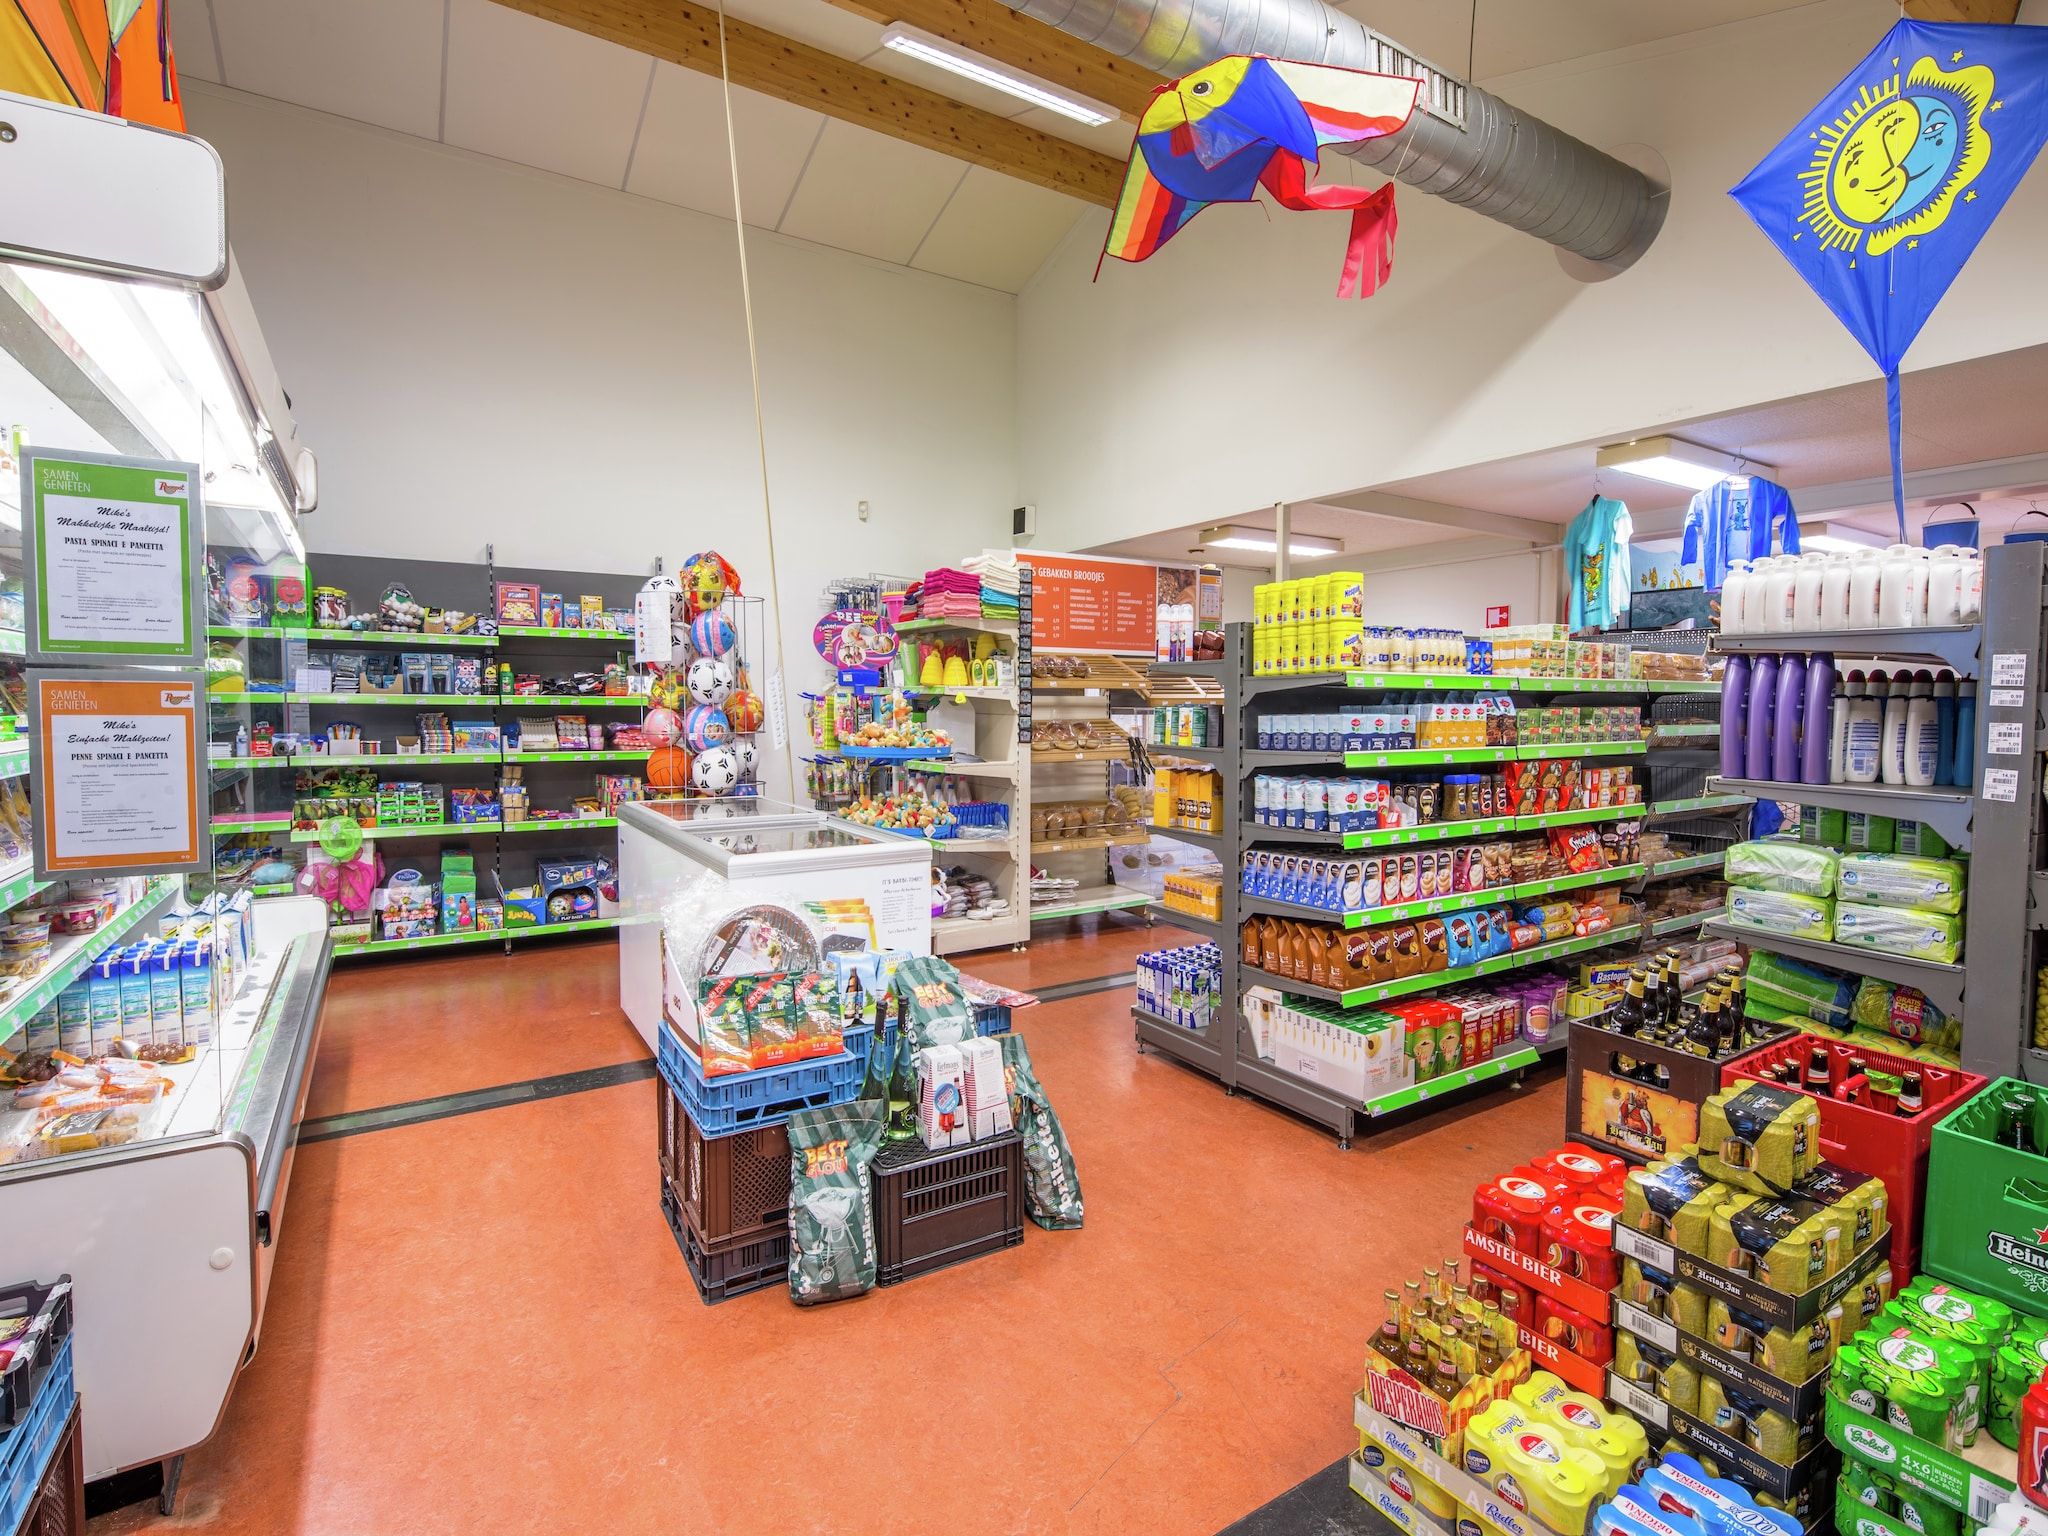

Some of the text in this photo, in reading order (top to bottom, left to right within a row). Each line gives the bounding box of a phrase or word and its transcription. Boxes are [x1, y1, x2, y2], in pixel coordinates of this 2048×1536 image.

[43, 469, 79, 481] SAMEN
[43, 479, 91, 492] GENIETEN
[97, 507, 131, 517] Mike's
[57, 517, 170, 533] Makkelijke Maaltijd!
[64, 537, 87, 546] PASTA
[91, 539, 118, 548] SPINACI
[130, 541, 163, 551] PANCETTA
[1038, 567, 1072, 580] GEBAKKEN
[1074, 570, 1105, 583] BROODJES
[50, 689, 86, 700] SAMEN
[51, 700, 98, 710] GENIETEN
[103, 720, 136, 729] Mike's
[67, 733, 171, 744] Einfache Mahlzeiten!
[71, 753, 93, 761] PENNE
[127, 752, 132, 760] E
[135, 752, 169, 760] PANCETTA
[1393, 928, 1415, 947] Senseo
[1423, 925, 1446, 946] Senseo
[1451, 923, 1471, 940] Senseo
[1346, 942, 1369, 962] Senseo
[1370, 935, 1390, 955] Senseo
[1596, 971, 1631, 985] Bastogne
[1895, 1002, 1920, 1013] FREE
[804, 1139, 849, 1166] BEST
[1031, 1106, 1074, 1213] brikette
[855, 1160, 875, 1267] briketten
[1465, 1229, 1562, 1288] AMSTEL BIER
[1997, 1237, 2048, 1271] Heine
[799, 1276, 812, 1295] 3
[1697, 1266, 1741, 1296] Hertog Jan
[1519, 1328, 1560, 1363] BIER
[1700, 1350, 1744, 1380] Hertog Jan
[1369, 1370, 1445, 1437] DESPERADOS
[1385, 1430, 1418, 1460] Radler
[1691, 1427, 1735, 1459] Hertog Jan
[1850, 1427, 1890, 1456] Grolsch
[1901, 1455, 1911, 1465] 4
[1921, 1464, 1931, 1475] 6
[1391, 1476, 1411, 1494] AMSTEL
[1500, 1484, 1522, 1504] AMSTEL
[1671, 1469, 1721, 1500] ORIGINAL
[1379, 1493, 1411, 1526] Radler
[1487, 1502, 1525, 1536] Radler
[1625, 1501, 1673, 1536] ORIGINAL
